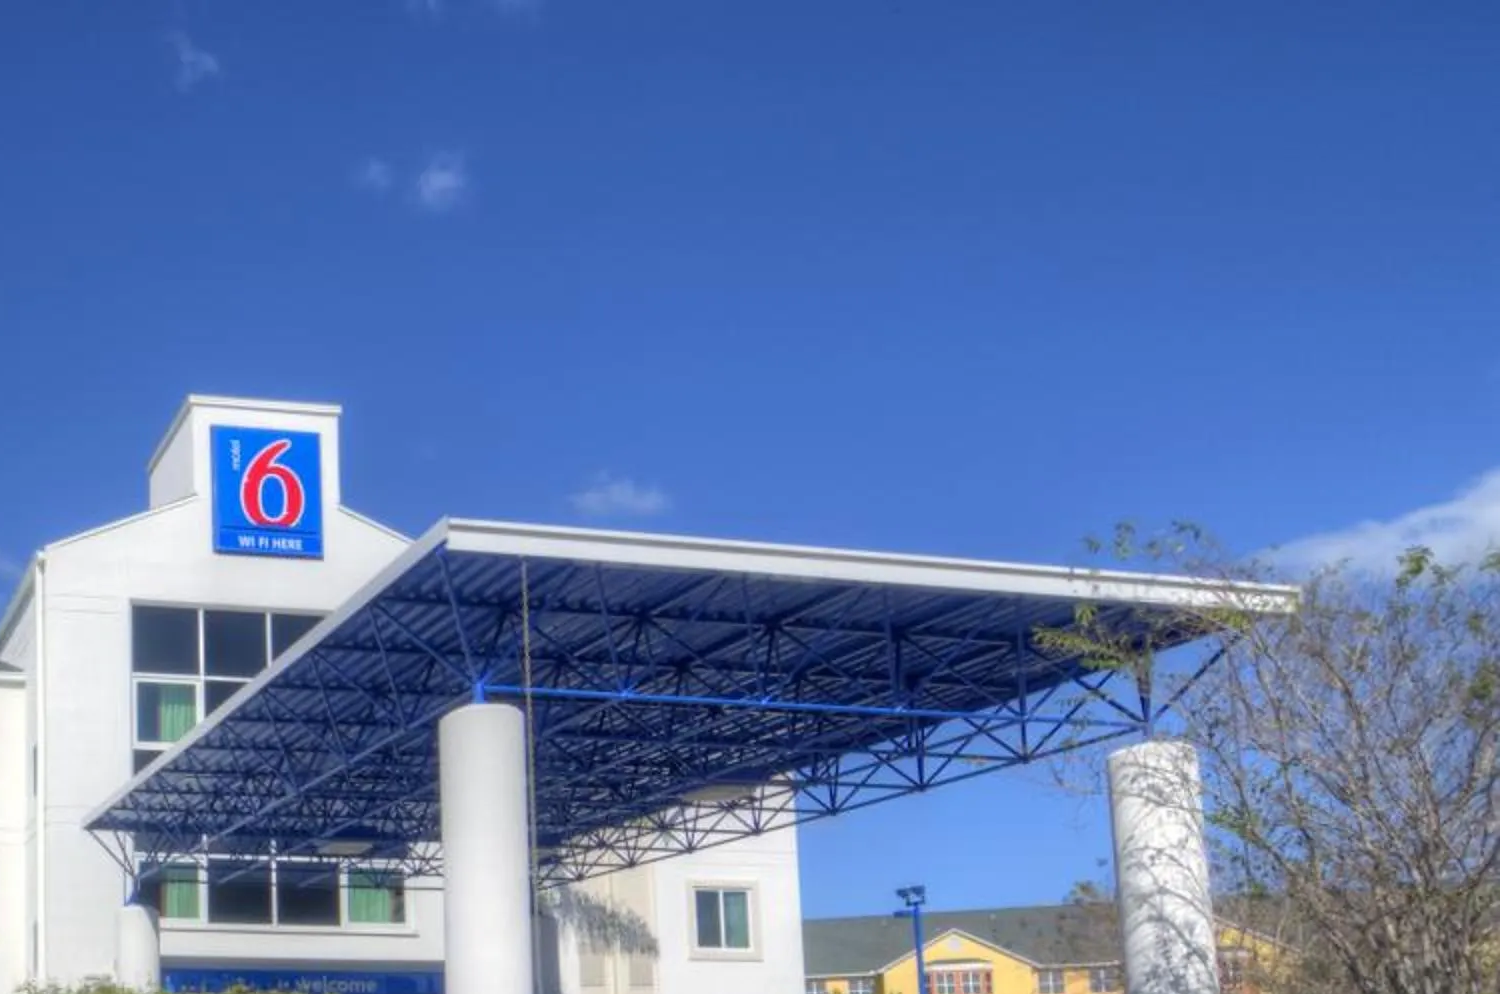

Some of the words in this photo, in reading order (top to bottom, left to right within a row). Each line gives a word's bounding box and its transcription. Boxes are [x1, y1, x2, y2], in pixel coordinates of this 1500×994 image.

[240, 438, 304, 527] 6
[238, 536, 255, 548] WI
[259, 537, 269, 549] FI
[272, 538, 303, 550] HERE
[297, 975, 378, 994] welcome
